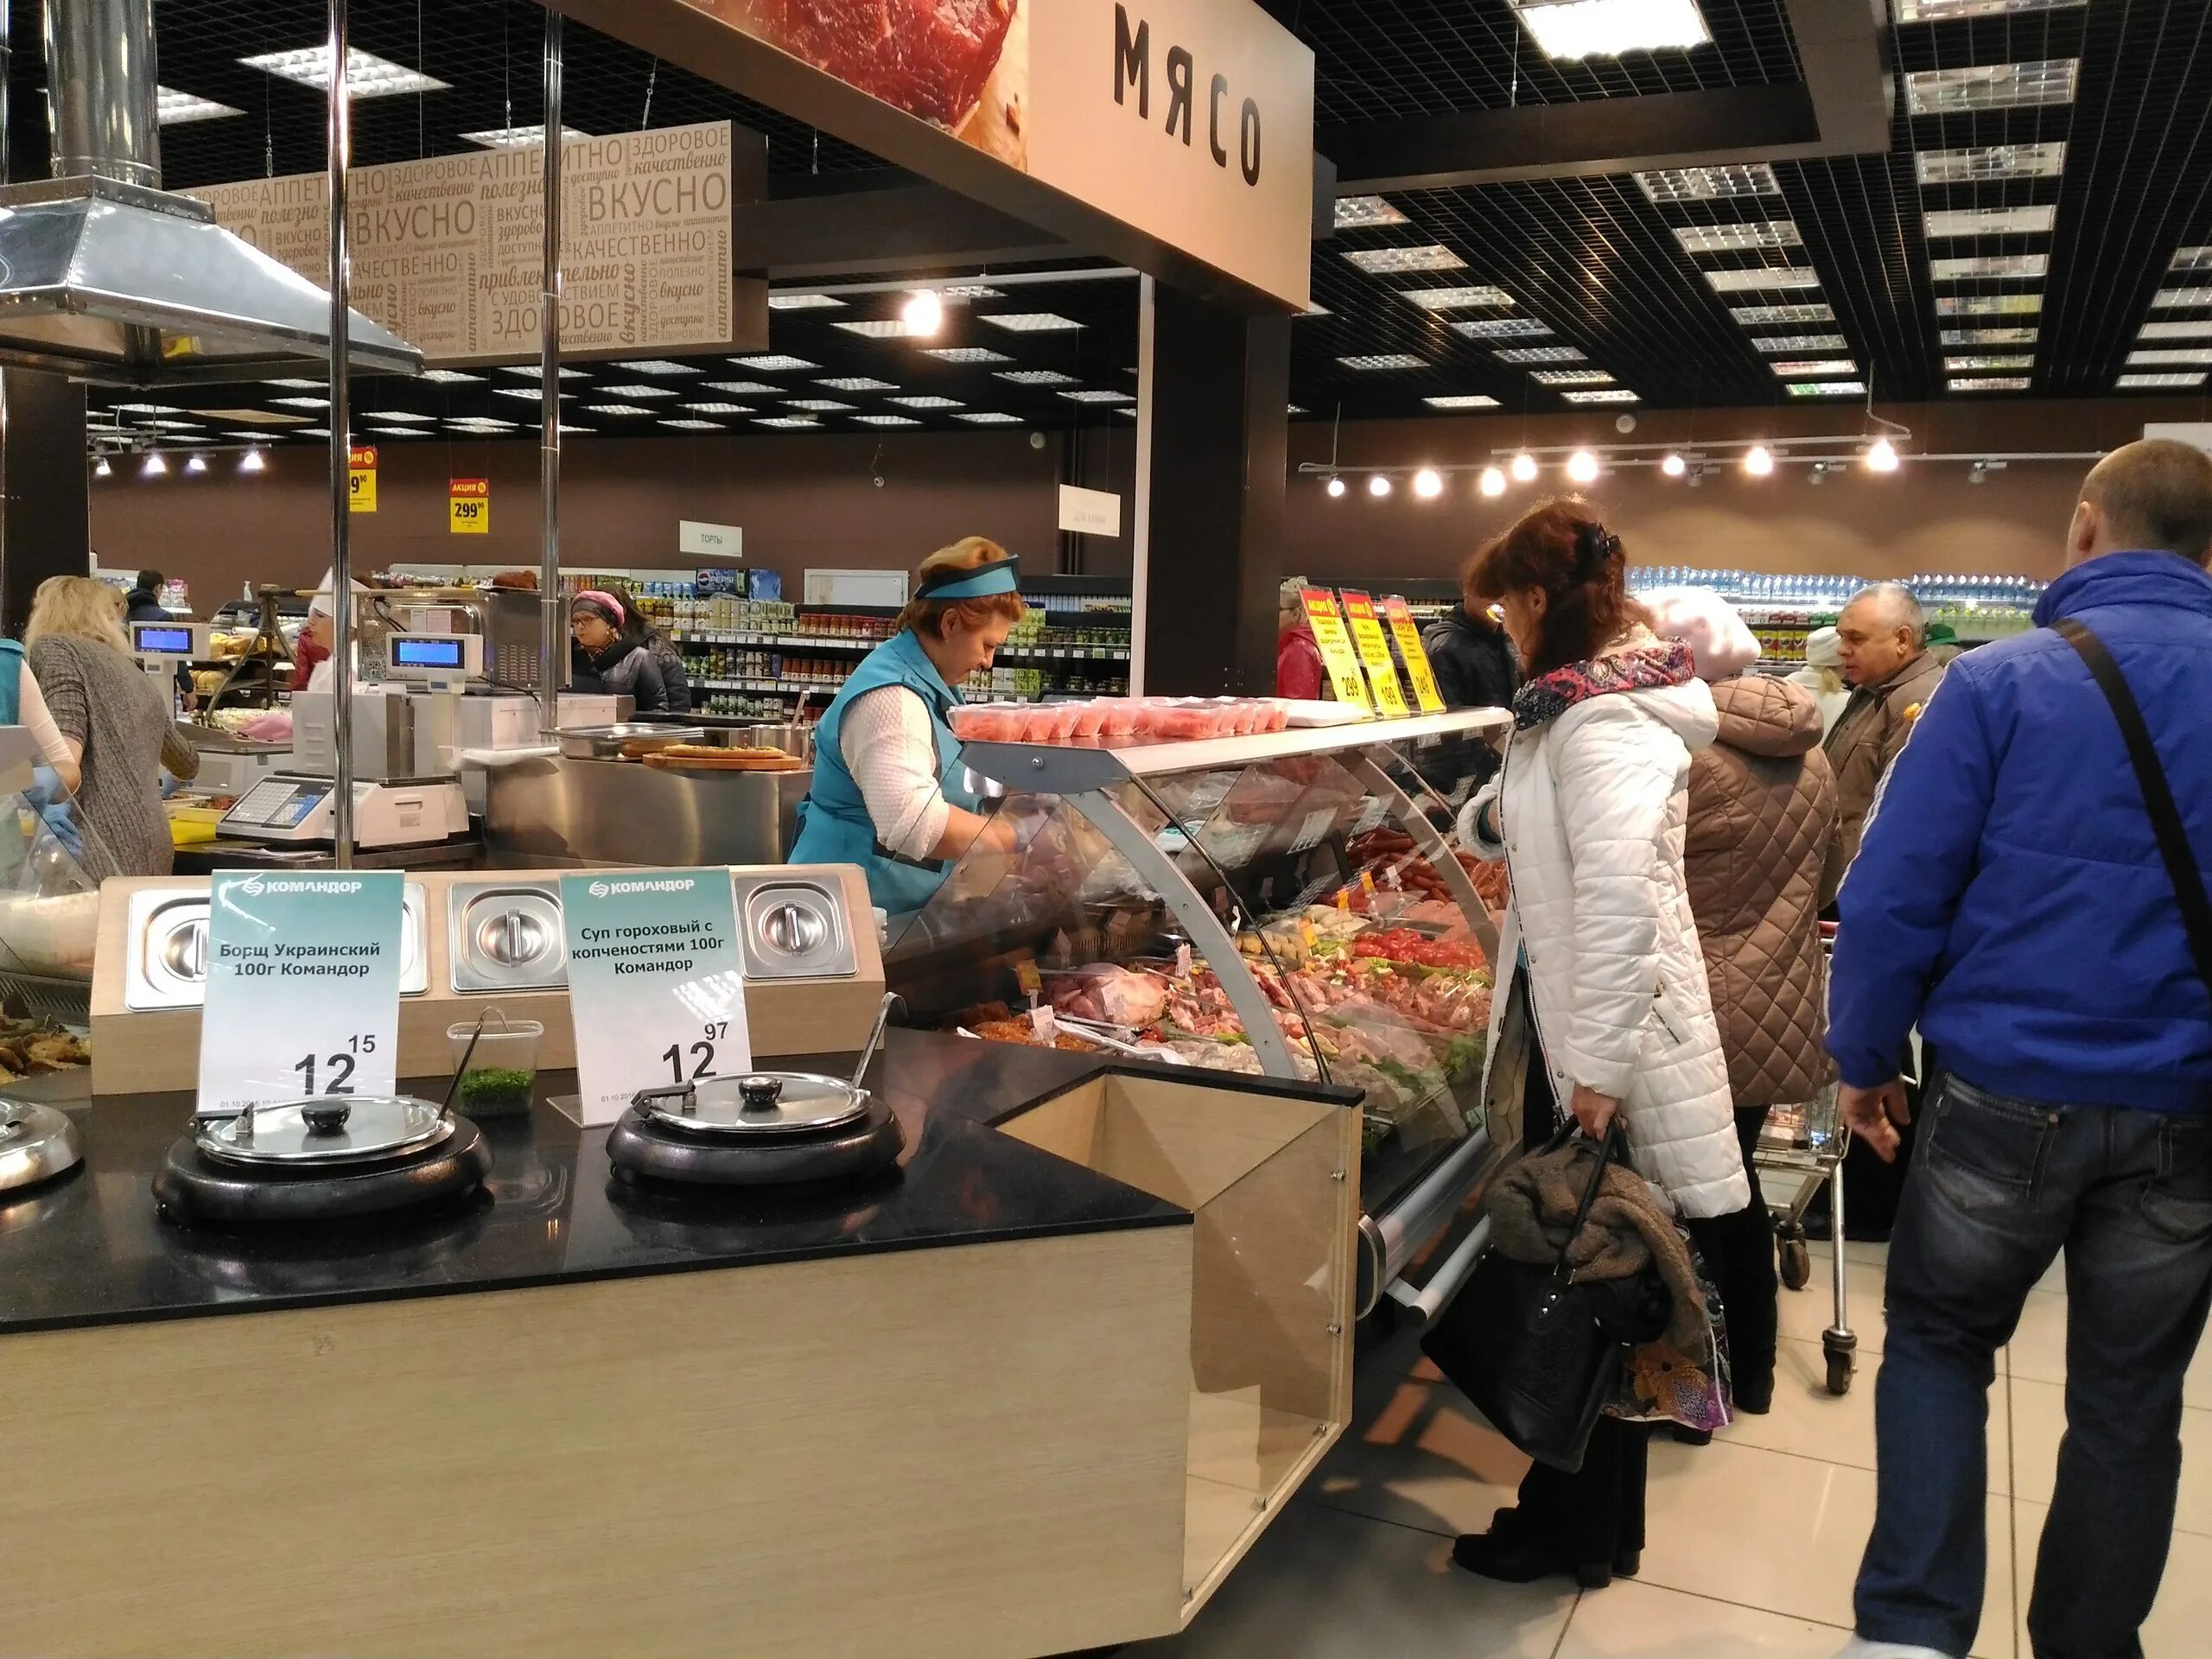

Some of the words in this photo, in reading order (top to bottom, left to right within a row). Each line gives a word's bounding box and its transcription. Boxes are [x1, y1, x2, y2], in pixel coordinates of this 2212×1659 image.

[1114, 2, 1261, 186] МЯСО
[632, 127, 728, 159] ЗДОРОВОЕ
[480, 139, 622, 180] АППЕИТНО
[634, 151, 726, 175] качественно
[393, 158, 476, 188] ЗДОРОВОЕ
[570, 169, 619, 188] доступно
[259, 170, 385, 207] АППЕТНО
[396, 181, 474, 202] качественно
[589, 173, 726, 221] ВКУСНО
[261, 205, 319, 226] полезно
[357, 200, 475, 245] ВКУСНО
[276, 228, 321, 245] ВКУСНО
[499, 218, 543, 242] здорово
[590, 220, 653, 236] АППЕТИТНО
[498, 242, 543, 256] ДОСТУПН
[573, 231, 705, 259] КАЧЕСТВЕННО
[353, 252, 457, 279] АЧЕСТВЕННО
[659, 265, 705, 278] ПОЛЕЗНО
[659, 282, 704, 302] вкусно
[718, 229, 727, 338] аппетитно
[418, 300, 455, 319] вкусно
[620, 263, 640, 344] вкусно
[493, 302, 619, 340] ЗДООВОЕ
[660, 315, 704, 328] доступно
[452, 483, 476, 493] АКЦИЯ
[454, 503, 477, 518] 299
[701, 533, 722, 544] ТОРТЫ
[1342, 677, 1359, 696] 299
[266, 881, 363, 893] КОМАНДОР
[610, 879, 695, 894] КОМАНДОР
[582, 928, 610, 942] Суп
[616, 920, 701, 939] гороховый
[705, 922, 713, 931] с
[219, 944, 268, 959] Борщ
[274, 942, 380, 959] Украинский
[572, 942, 685, 959] копченостями
[691, 938, 724, 950] 100г
[235, 963, 276, 976] 100г
[281, 963, 370, 976] Командор
[614, 958, 693, 975] Командор
[663, 1041, 716, 1083] 12
[704, 1021, 728, 1040] 97
[295, 1053, 356, 1096] 12
[348, 1034, 376, 1053] 15
